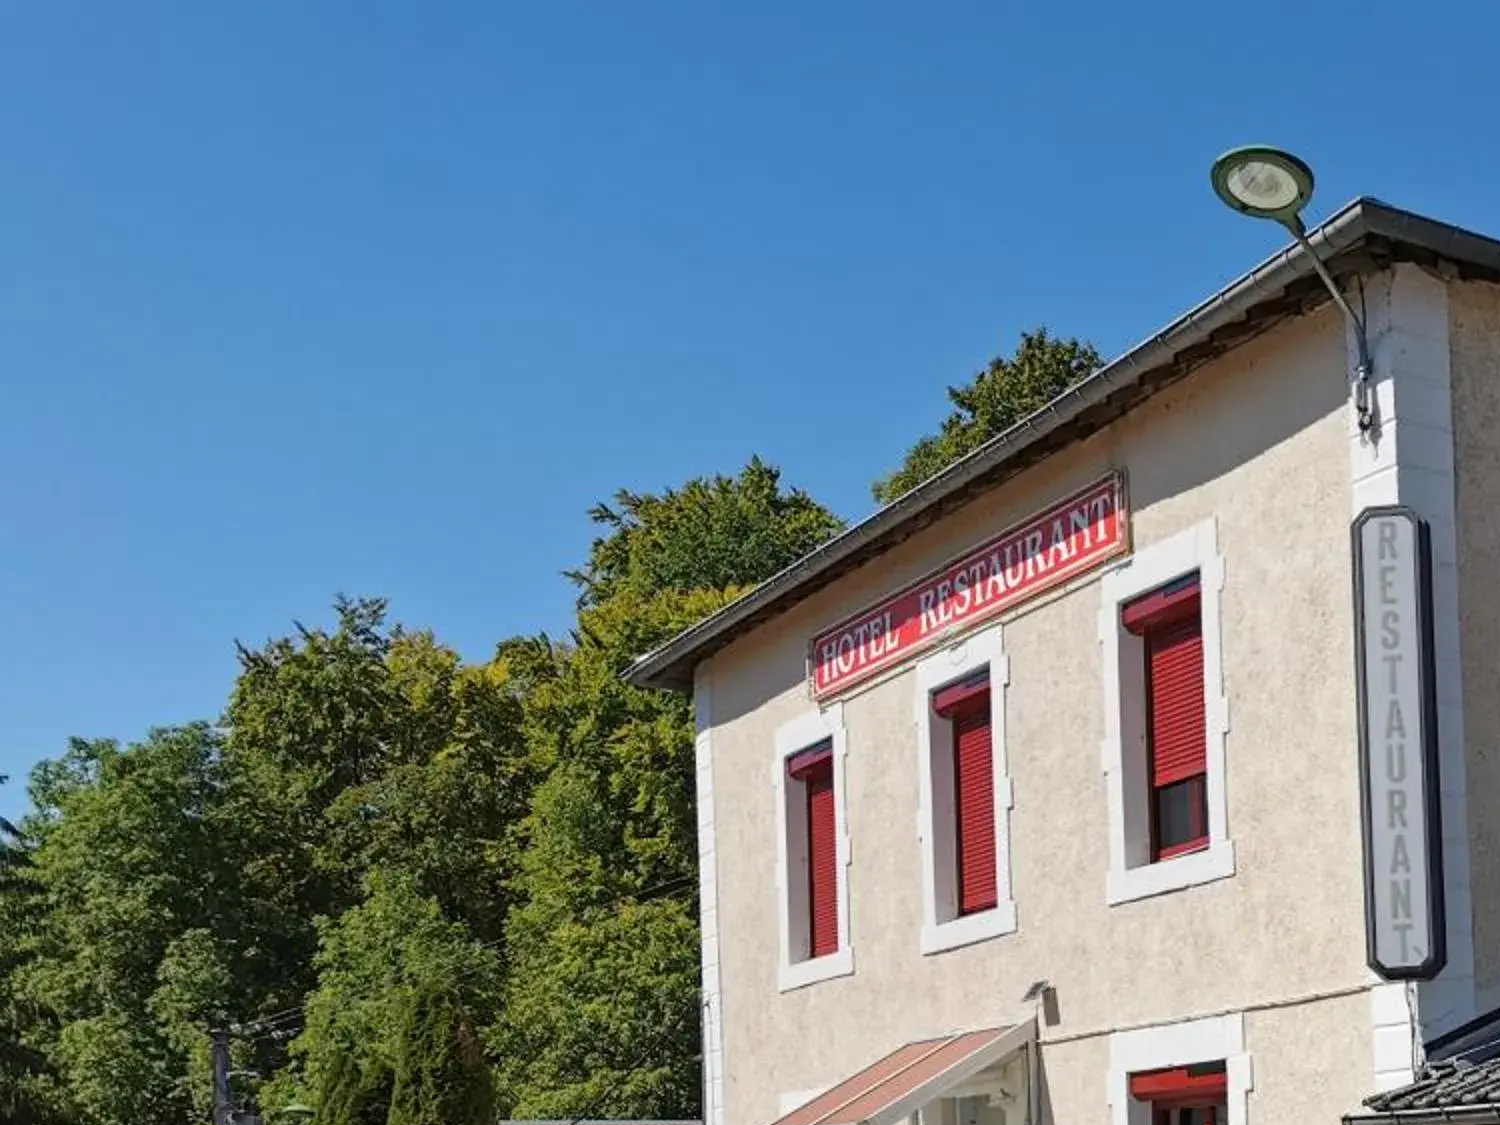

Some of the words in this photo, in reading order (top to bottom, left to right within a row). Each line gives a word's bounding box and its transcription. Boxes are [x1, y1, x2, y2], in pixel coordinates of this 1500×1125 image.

[820, 612, 900, 685] HOTEL
[918, 492, 1112, 636] RESTAURANT
[1378, 520, 1415, 964] RESTAURANT
